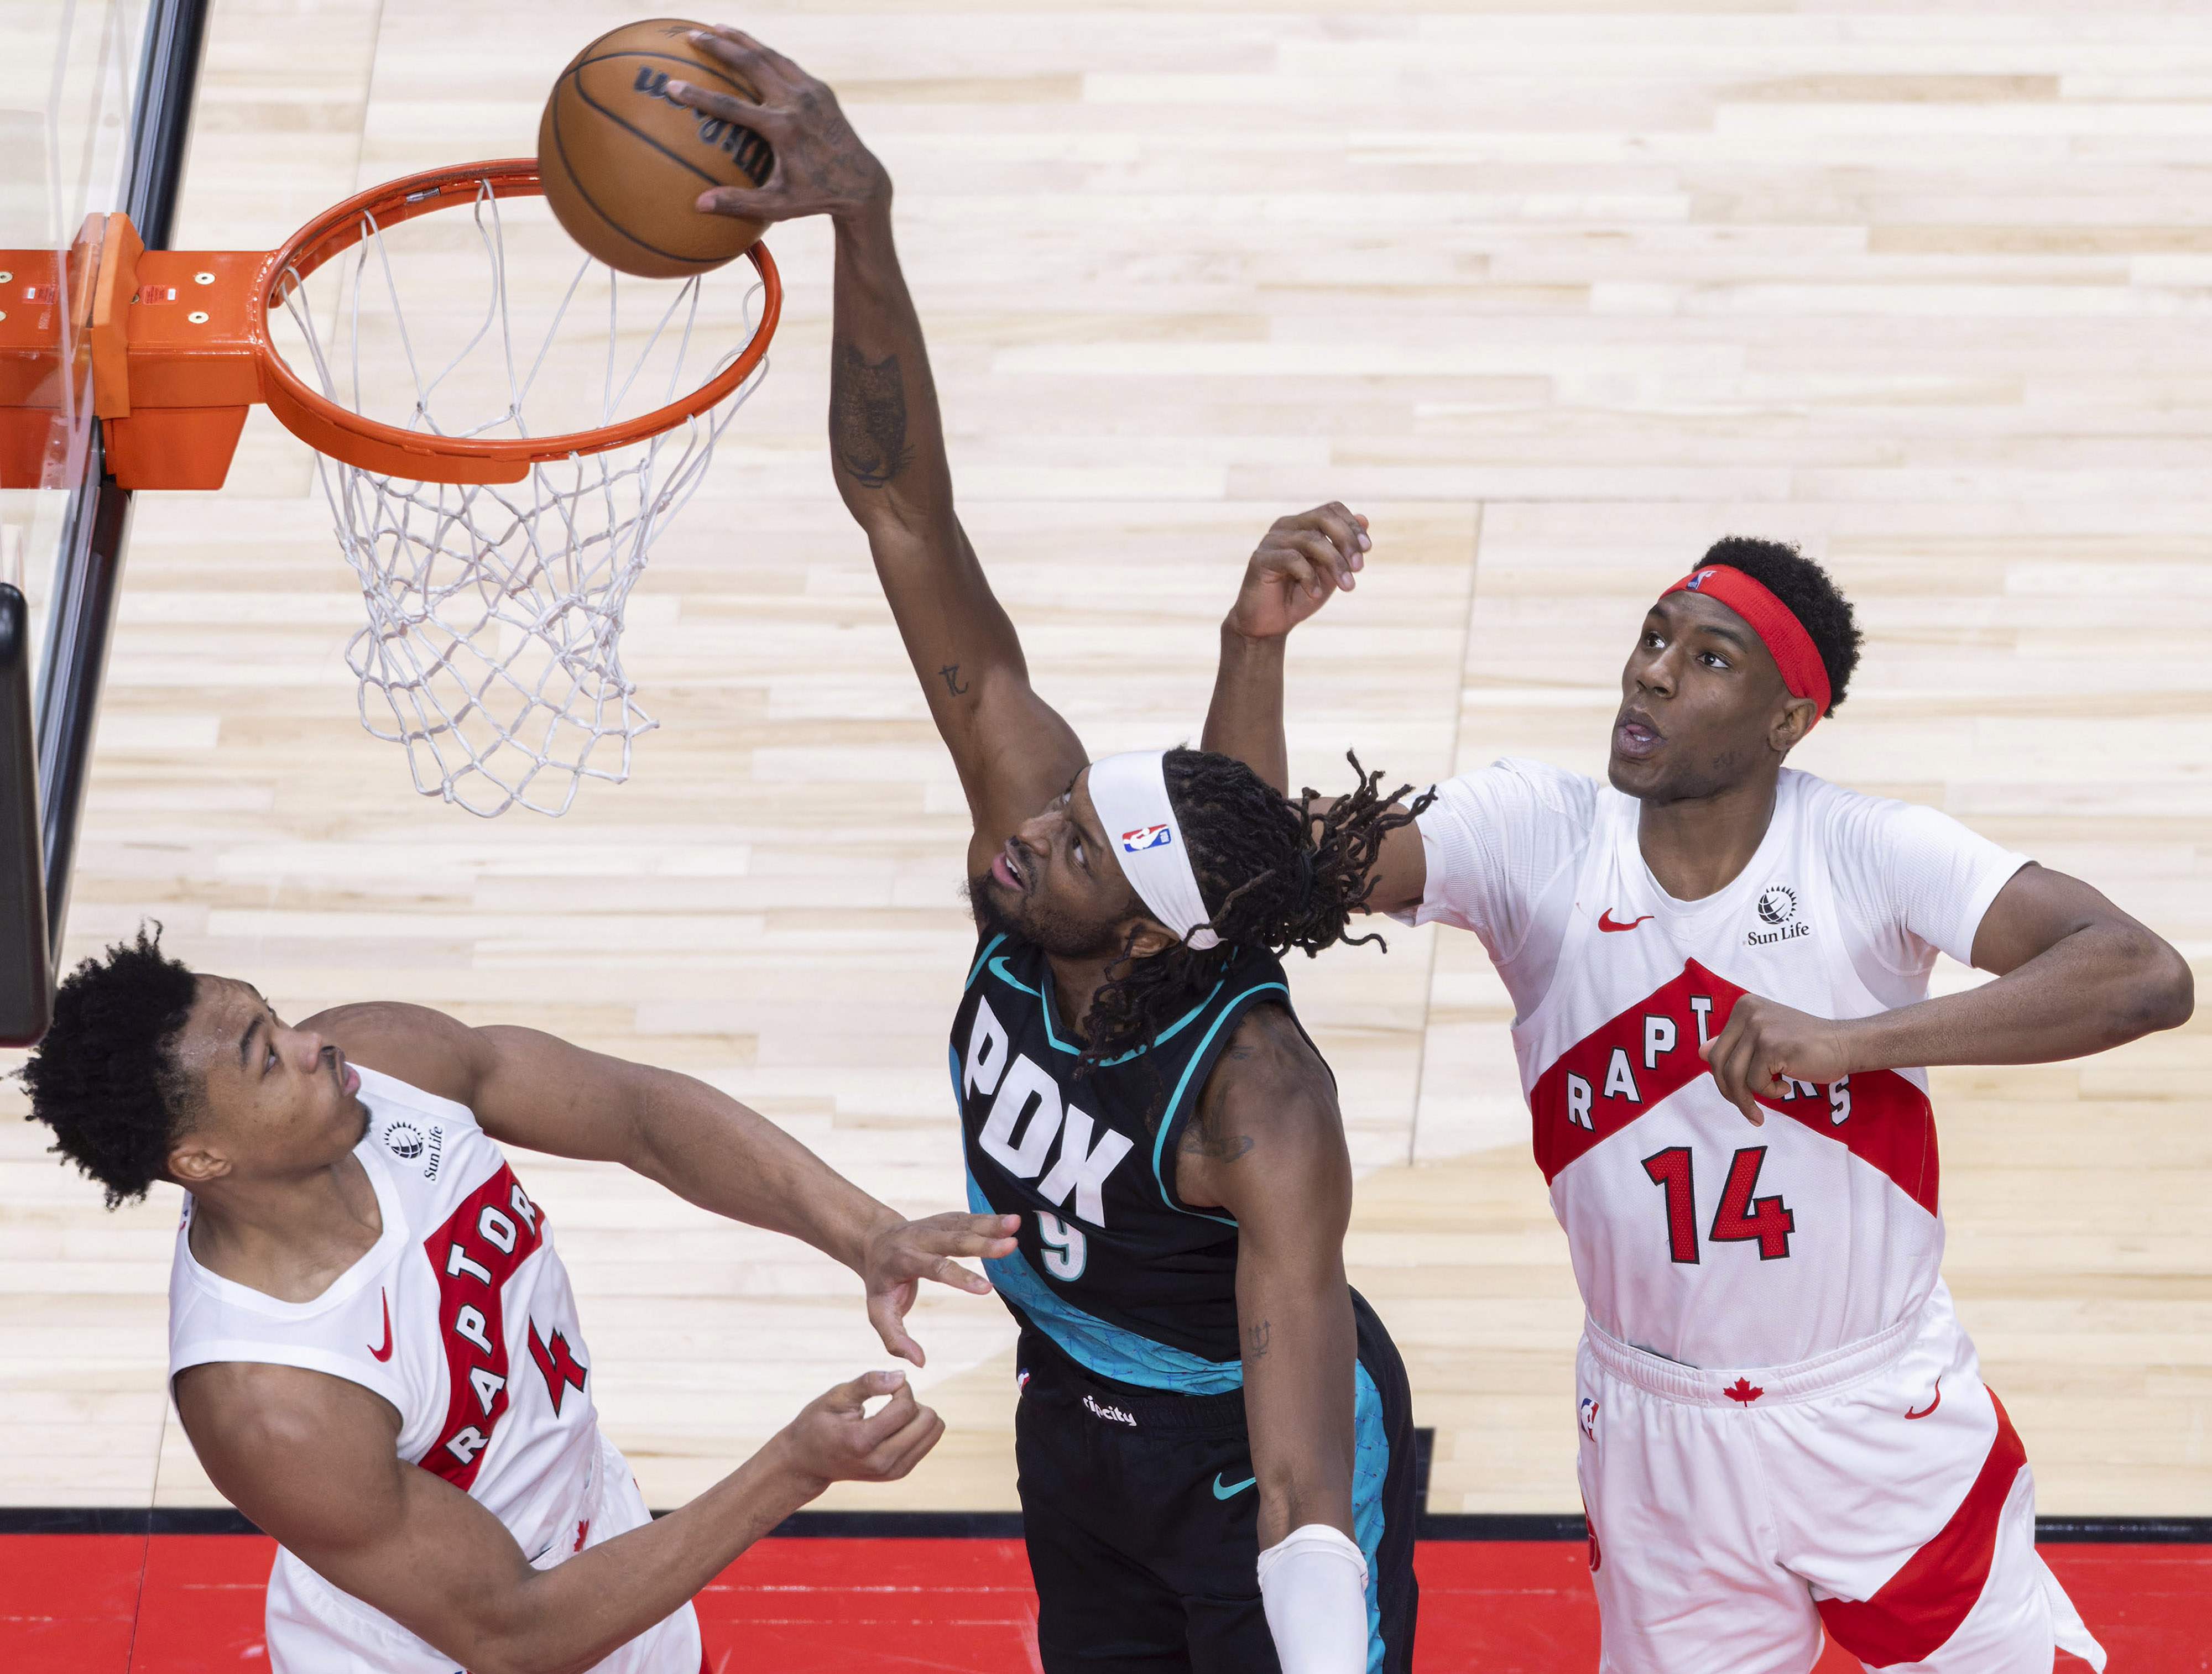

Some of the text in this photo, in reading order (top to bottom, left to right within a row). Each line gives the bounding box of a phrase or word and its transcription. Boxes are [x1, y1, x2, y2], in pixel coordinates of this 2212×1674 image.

[1748, 922, 1810, 946] Sun Life
[964, 995, 1135, 1228] PDX
[1566, 995, 1851, 1132] RAPTS
[424, 1126, 443, 1181] Sun Life
[1641, 1145, 1795, 1264] 14
[1033, 1210, 1087, 1282] 9
[528, 1314, 588, 1420] 4
